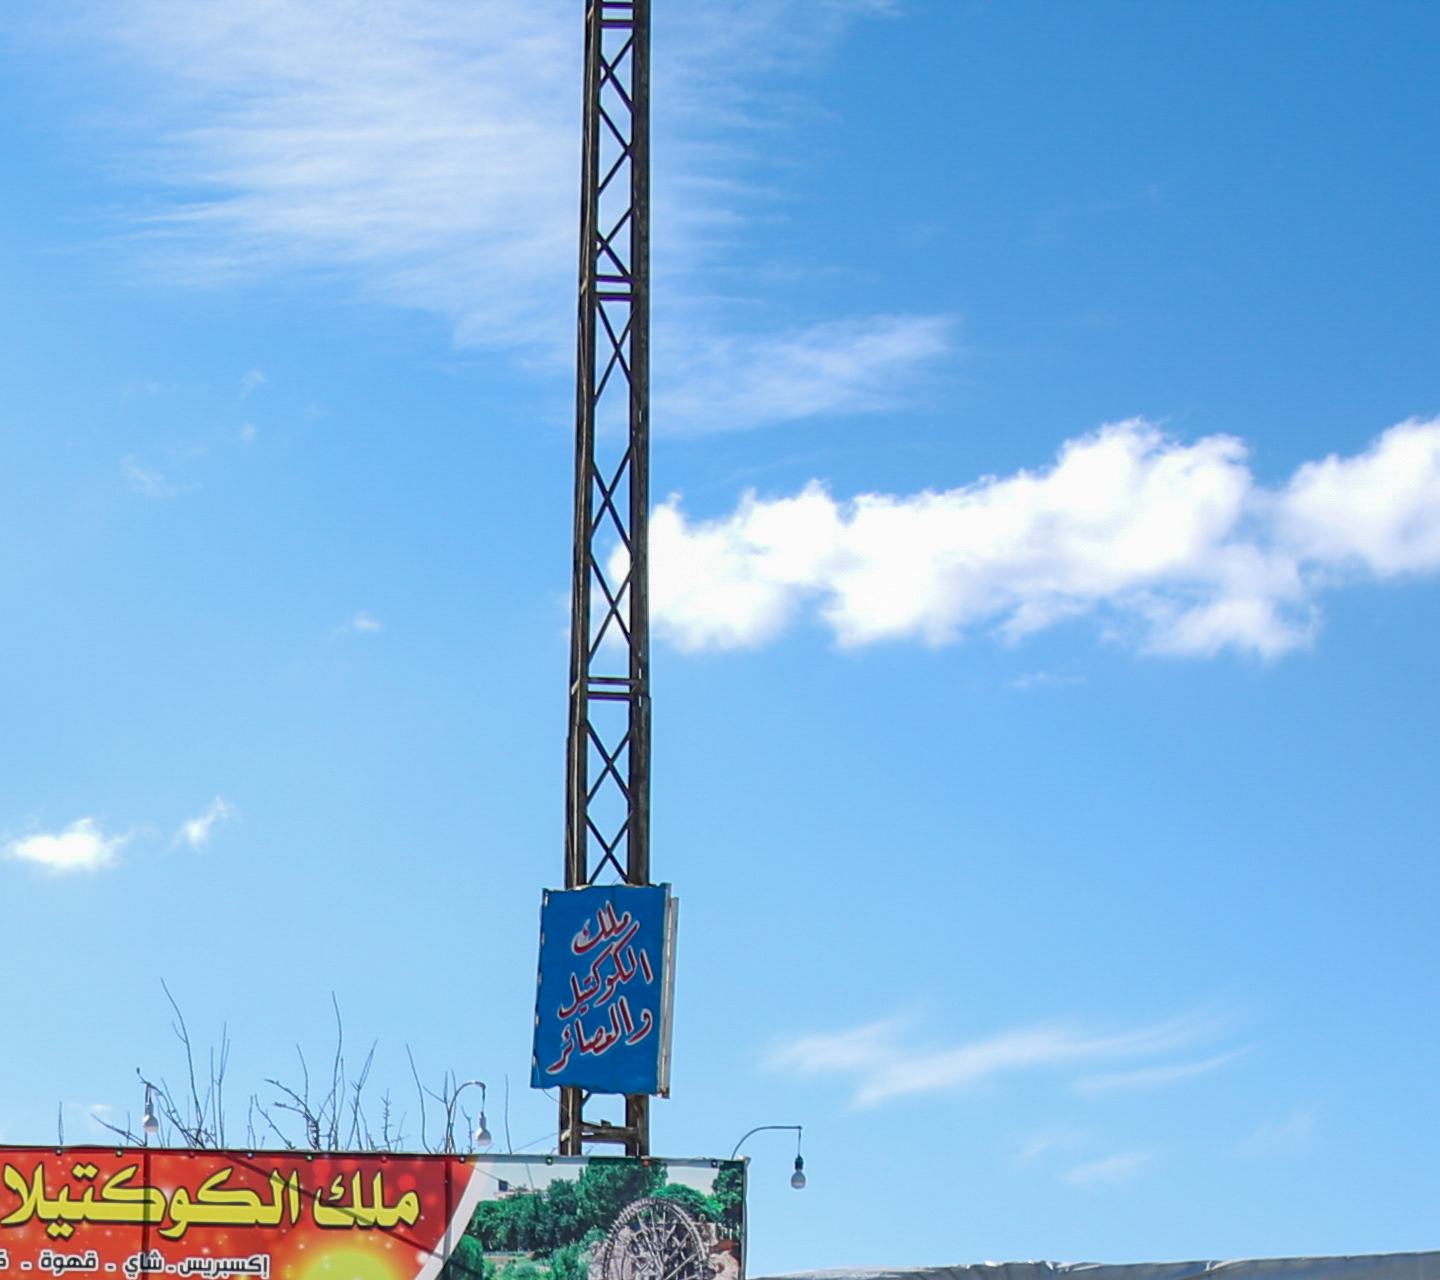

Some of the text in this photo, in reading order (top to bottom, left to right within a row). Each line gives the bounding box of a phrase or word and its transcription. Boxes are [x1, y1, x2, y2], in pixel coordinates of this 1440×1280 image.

[572, 900, 632, 955] ملك
[557, 920, 654, 1020] الكوكتيل
[546, 996, 654, 1075] والعصائر
[313, 1169, 420, 1228] ملك
[40, 1250, 98, 1276] قهوة
[125, 1250, 164, 1279] شاي
[180, 1254, 270, 1279] إكسبريس
